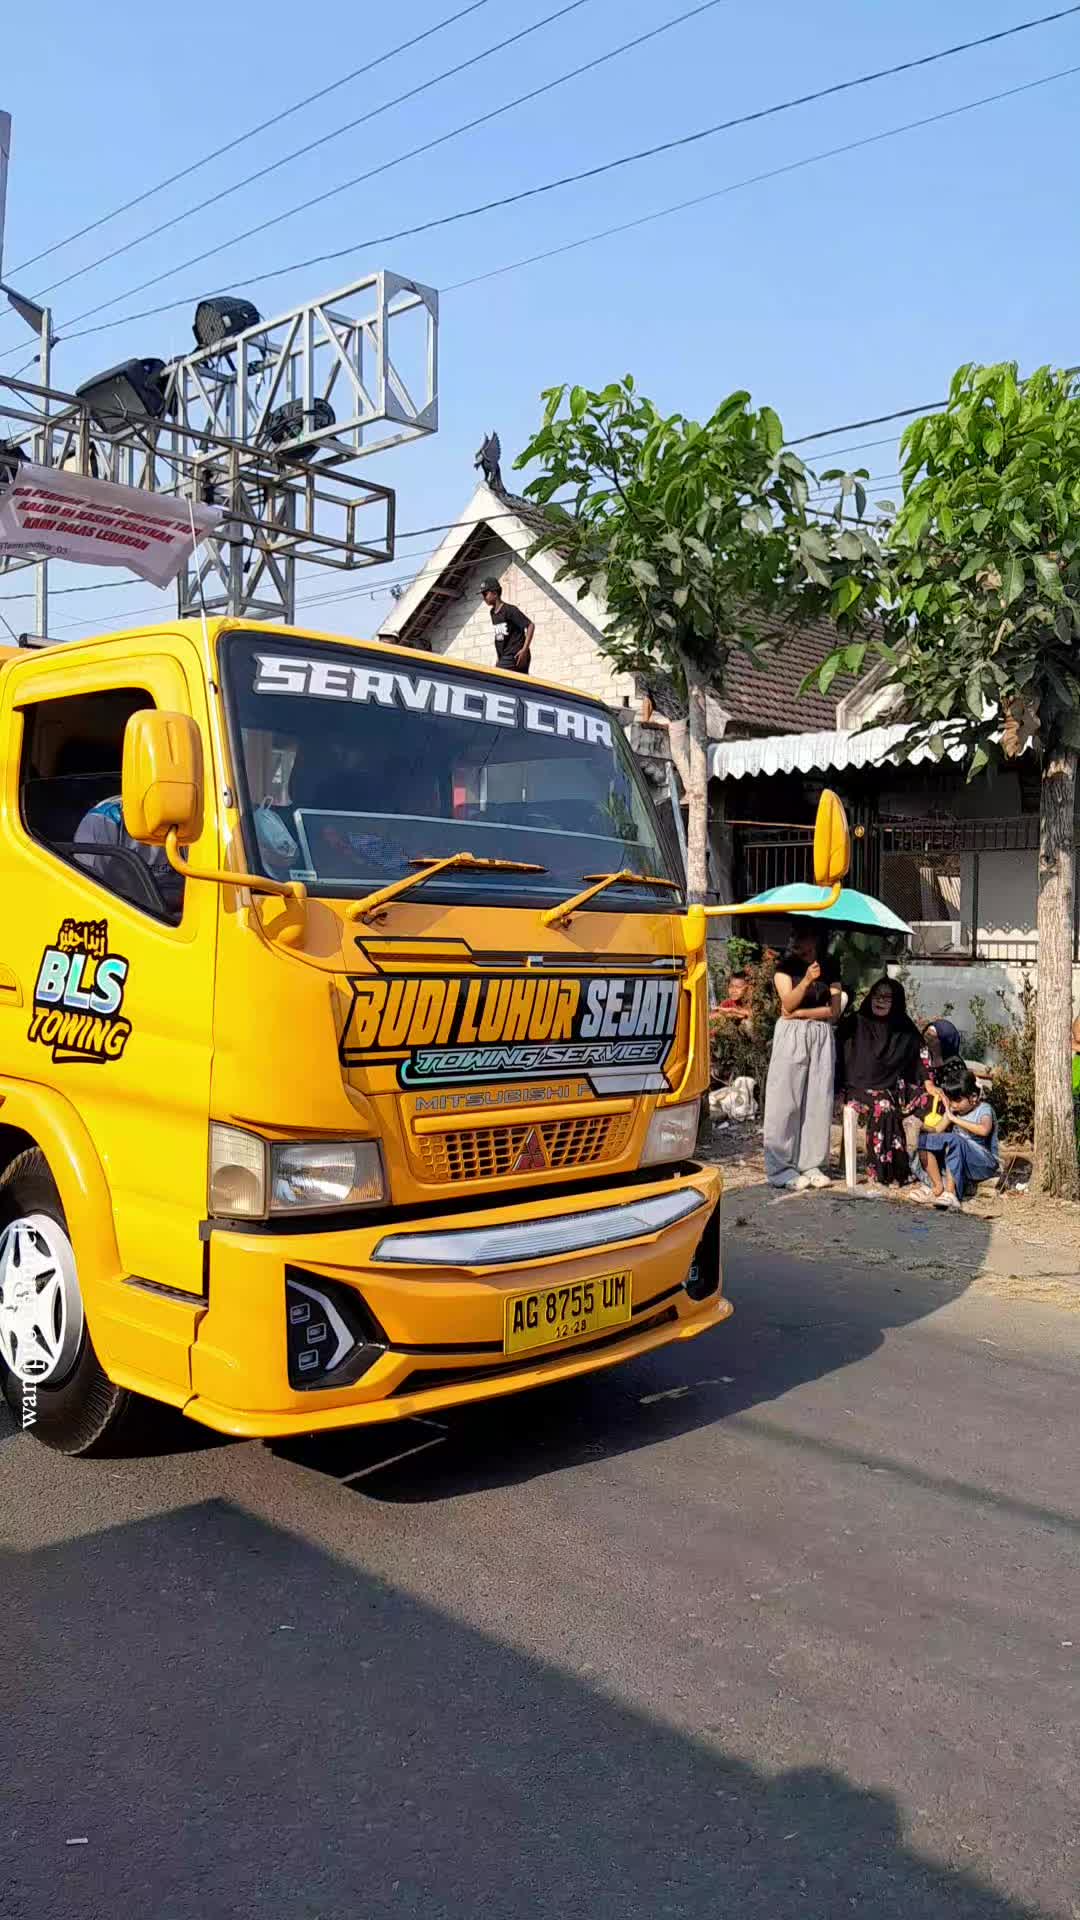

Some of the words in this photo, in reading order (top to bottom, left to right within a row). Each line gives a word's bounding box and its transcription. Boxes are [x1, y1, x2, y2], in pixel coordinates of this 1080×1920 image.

[22, 517, 57, 530] KAMI
[56, 521, 97, 537] BALAS
[96, 530, 151, 550] LEDAKAN
[58, 508, 77, 518] DI
[255, 655, 517, 726] SERVICE
[523, 699, 613, 748] CAR
[36, 950, 127, 1014] BLS
[30, 1007, 131, 1056] TOWING
[344, 980, 459, 1048] BUDI
[457, 979, 581, 1044] LUHUR
[580, 979, 679, 1038] SEJATI
[416, 1084, 569, 1111] MITSUBISHI
[513, 1297, 538, 1333] AG
[546, 1283, 594, 1323] 8755
[602, 1276, 626, 1308] UM
